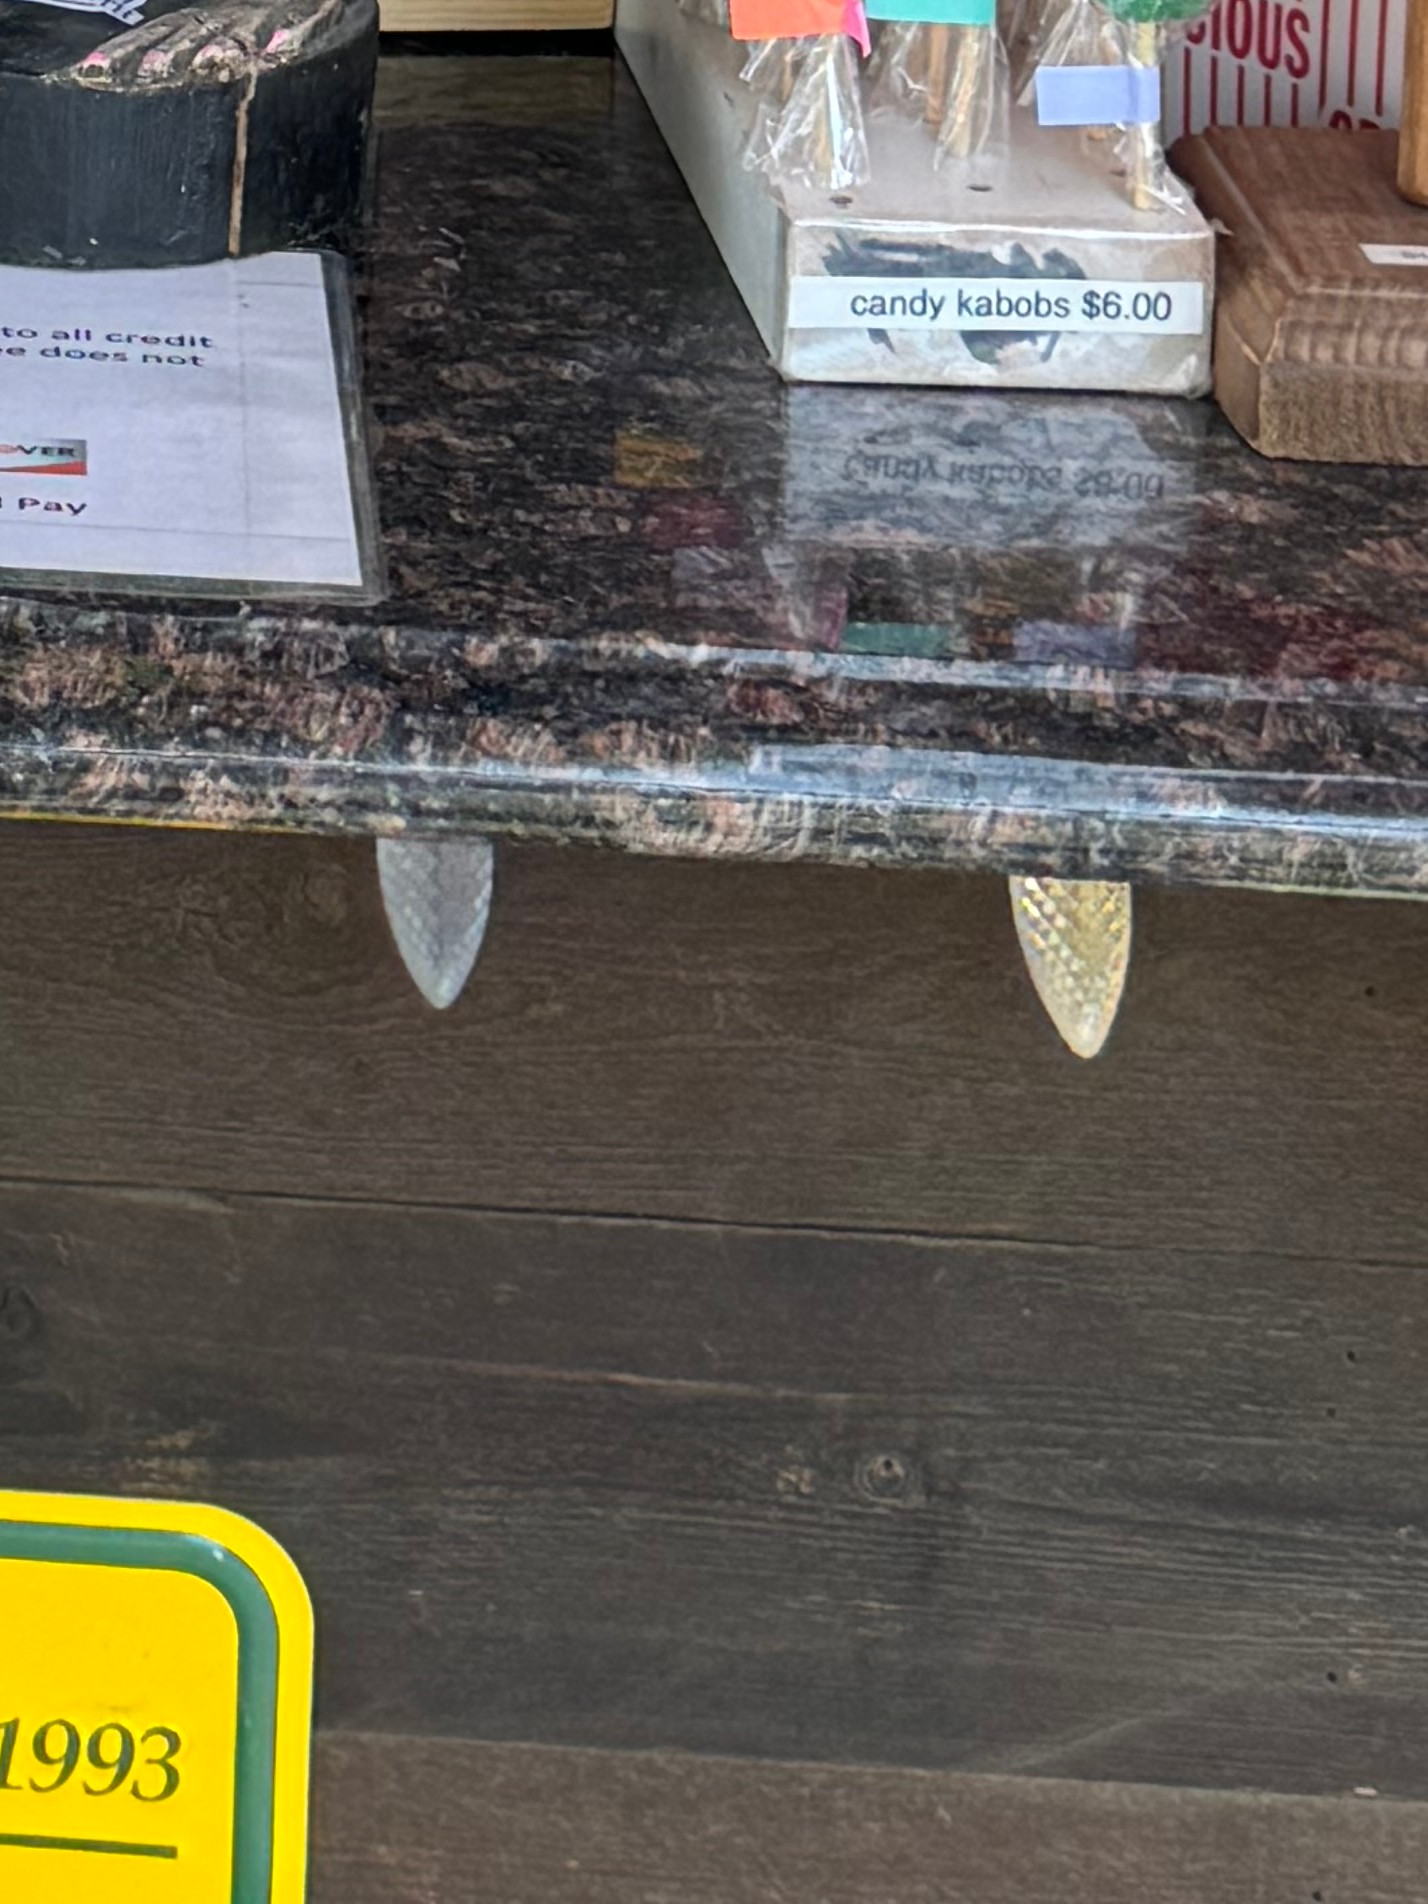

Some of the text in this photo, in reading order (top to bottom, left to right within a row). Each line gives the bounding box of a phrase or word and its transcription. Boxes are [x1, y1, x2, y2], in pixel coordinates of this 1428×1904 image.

[850, 288, 1172, 322] candy kabobs $6.00
[0, 326, 39, 340] to
[51, 328, 93, 342] all
[105, 331, 215, 349] credit
[40, 345, 128, 364] does
[141, 351, 205, 368] not
[18, 496, 87, 516] Pay
